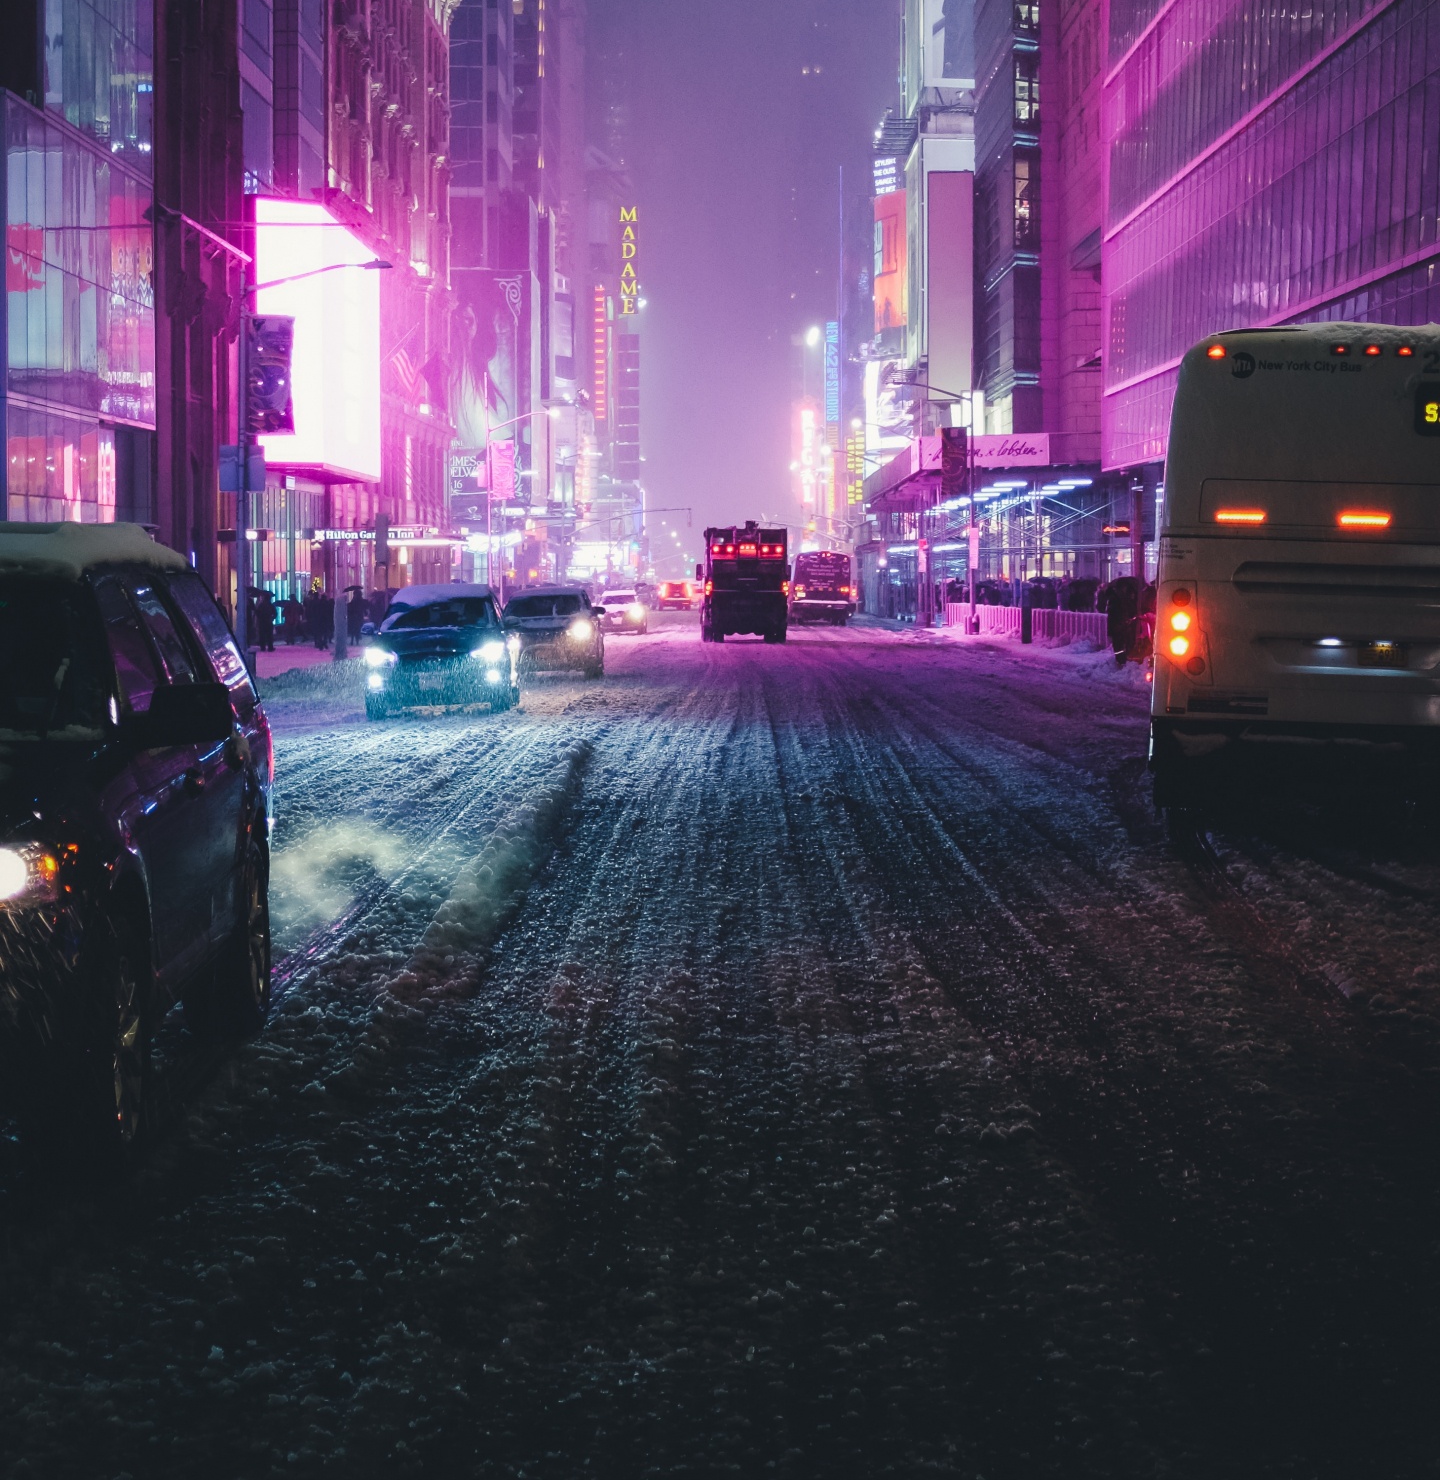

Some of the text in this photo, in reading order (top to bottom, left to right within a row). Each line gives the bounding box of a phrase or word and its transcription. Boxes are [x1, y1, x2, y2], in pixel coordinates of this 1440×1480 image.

[619, 206, 637, 314] MADAME
[826, 321, 838, 343] NEW
[1258, 360, 1362, 373] New York City Bus
[827, 380, 838, 421] STUDIOS
[1425, 402, 1440, 423] S
[997, 439, 1038, 457] lobster
[451, 455, 477, 467] IMES
[454, 480, 463, 489] 16
[326, 529, 415, 540] Hilton Garn Inn
